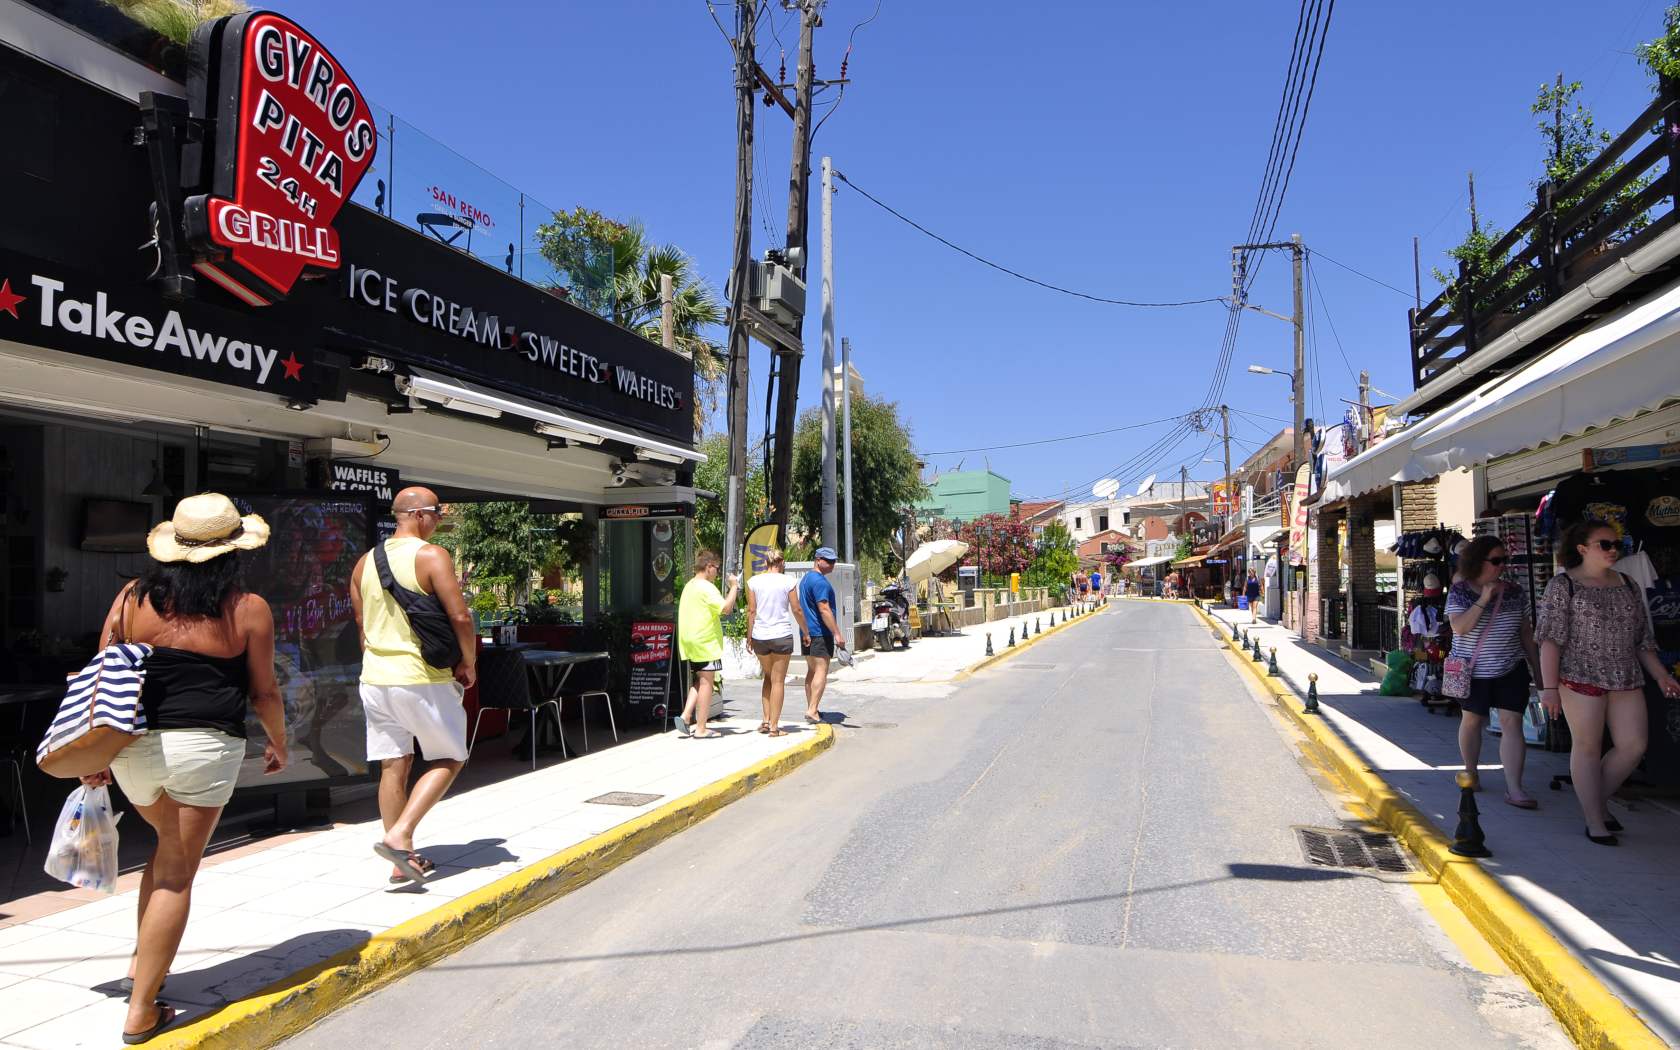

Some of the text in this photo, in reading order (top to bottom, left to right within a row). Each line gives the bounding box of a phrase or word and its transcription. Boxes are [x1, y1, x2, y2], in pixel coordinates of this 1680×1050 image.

[255, 24, 373, 163] GYROS
[253, 88, 344, 198] PITA
[256, 156, 319, 220] 24H
[433, 186, 456, 209] SAN
[460, 200, 491, 227] REMO
[218, 205, 338, 263] GRILL
[31, 274, 279, 385] TakeAway
[350, 263, 675, 409] ICE CREAM SWEETS WAFFLES
[334, 465, 387, 485] WAFFLES
